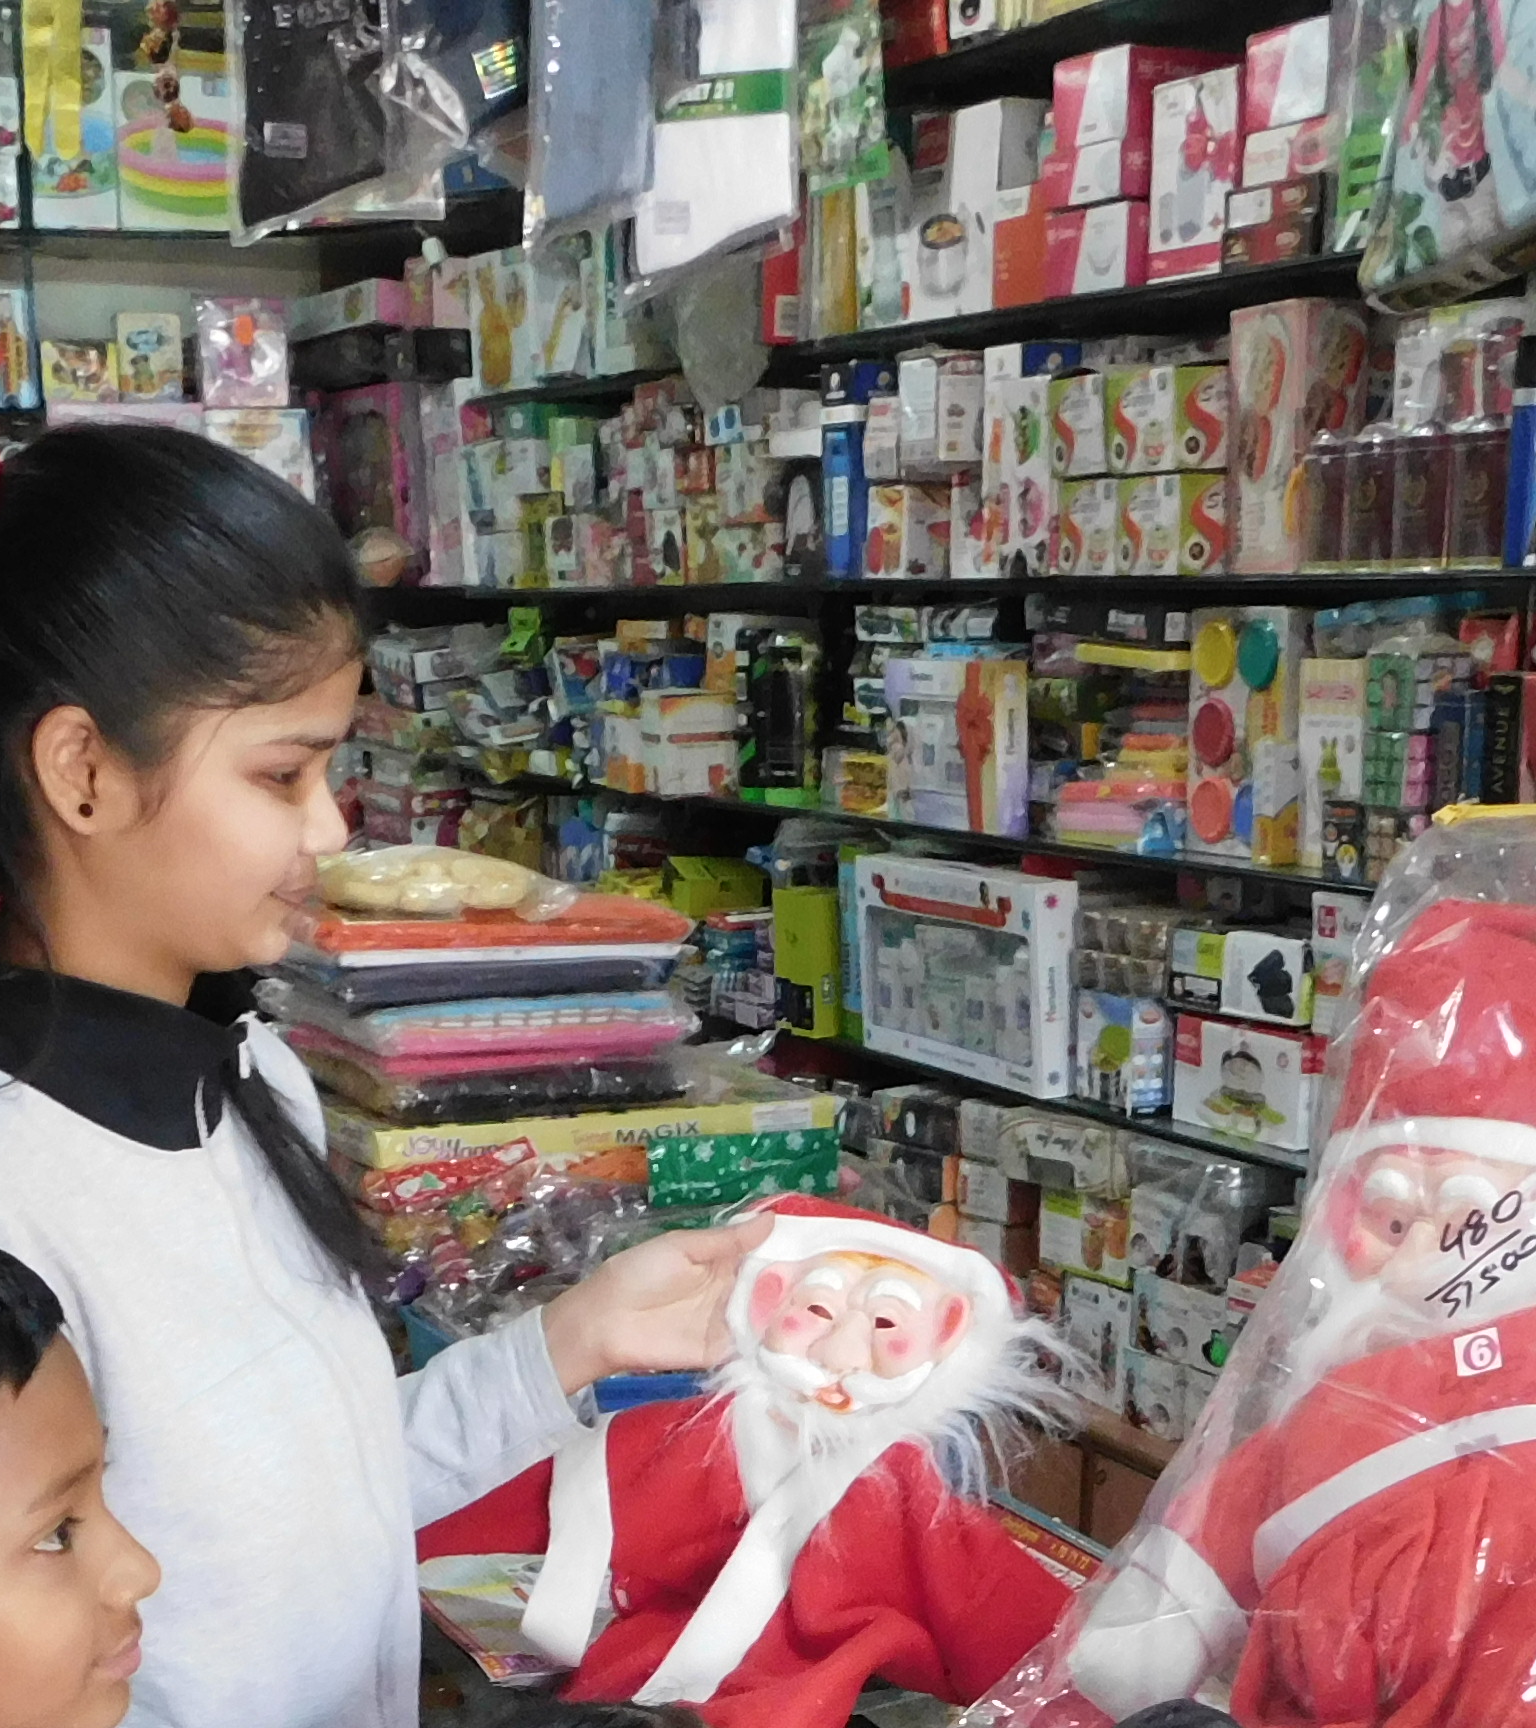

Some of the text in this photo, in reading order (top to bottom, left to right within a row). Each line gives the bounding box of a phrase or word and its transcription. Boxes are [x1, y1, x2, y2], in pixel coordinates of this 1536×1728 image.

[1491, 707, 1510, 795] AVENUE
[616, 1119, 701, 1145] MAGIX
[1439, 1189, 1524, 1261] 480
